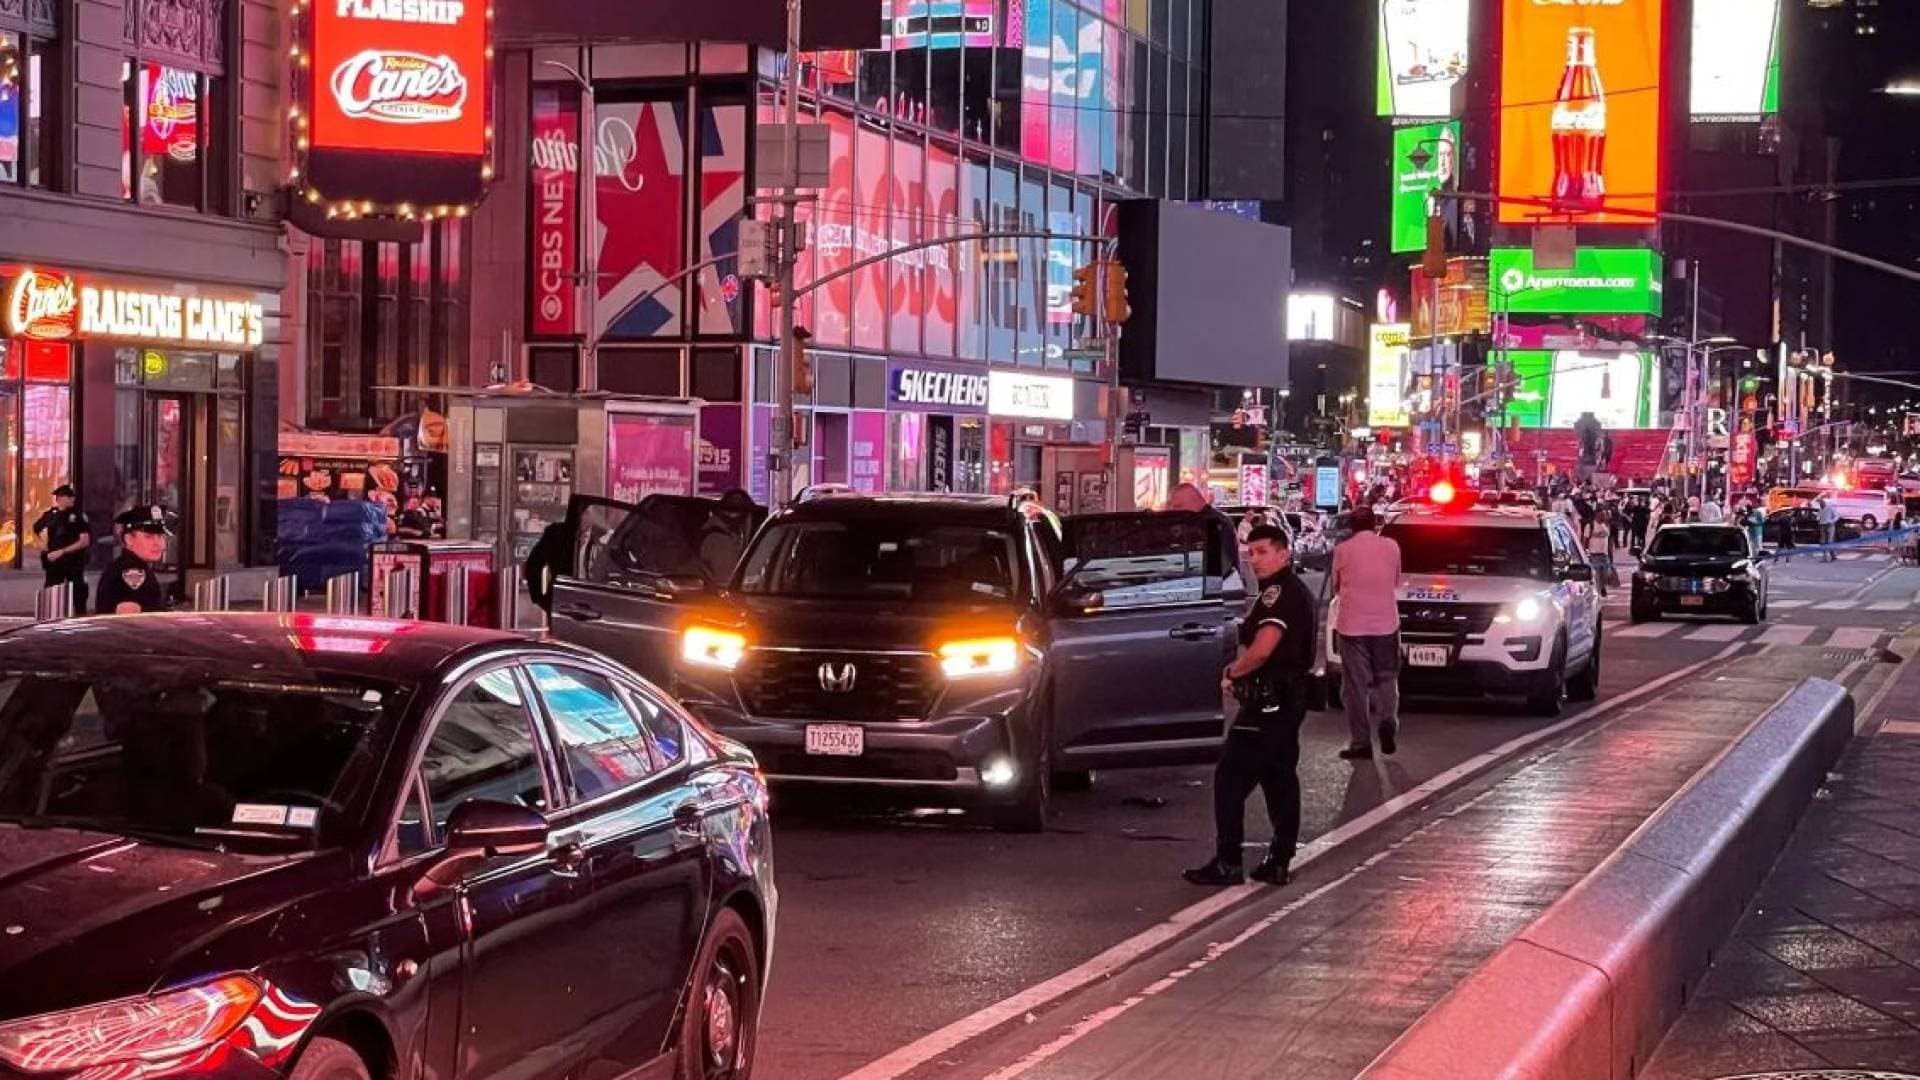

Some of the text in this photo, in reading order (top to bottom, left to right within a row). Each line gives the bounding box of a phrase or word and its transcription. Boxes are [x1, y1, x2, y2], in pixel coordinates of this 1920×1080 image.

[540, 230, 563, 292] CBS
[1525, 274, 1636, 289] Apartments.com
[81, 287, 263, 345] RAISING CANE'S
[898, 368, 988, 406] SKECHERS
